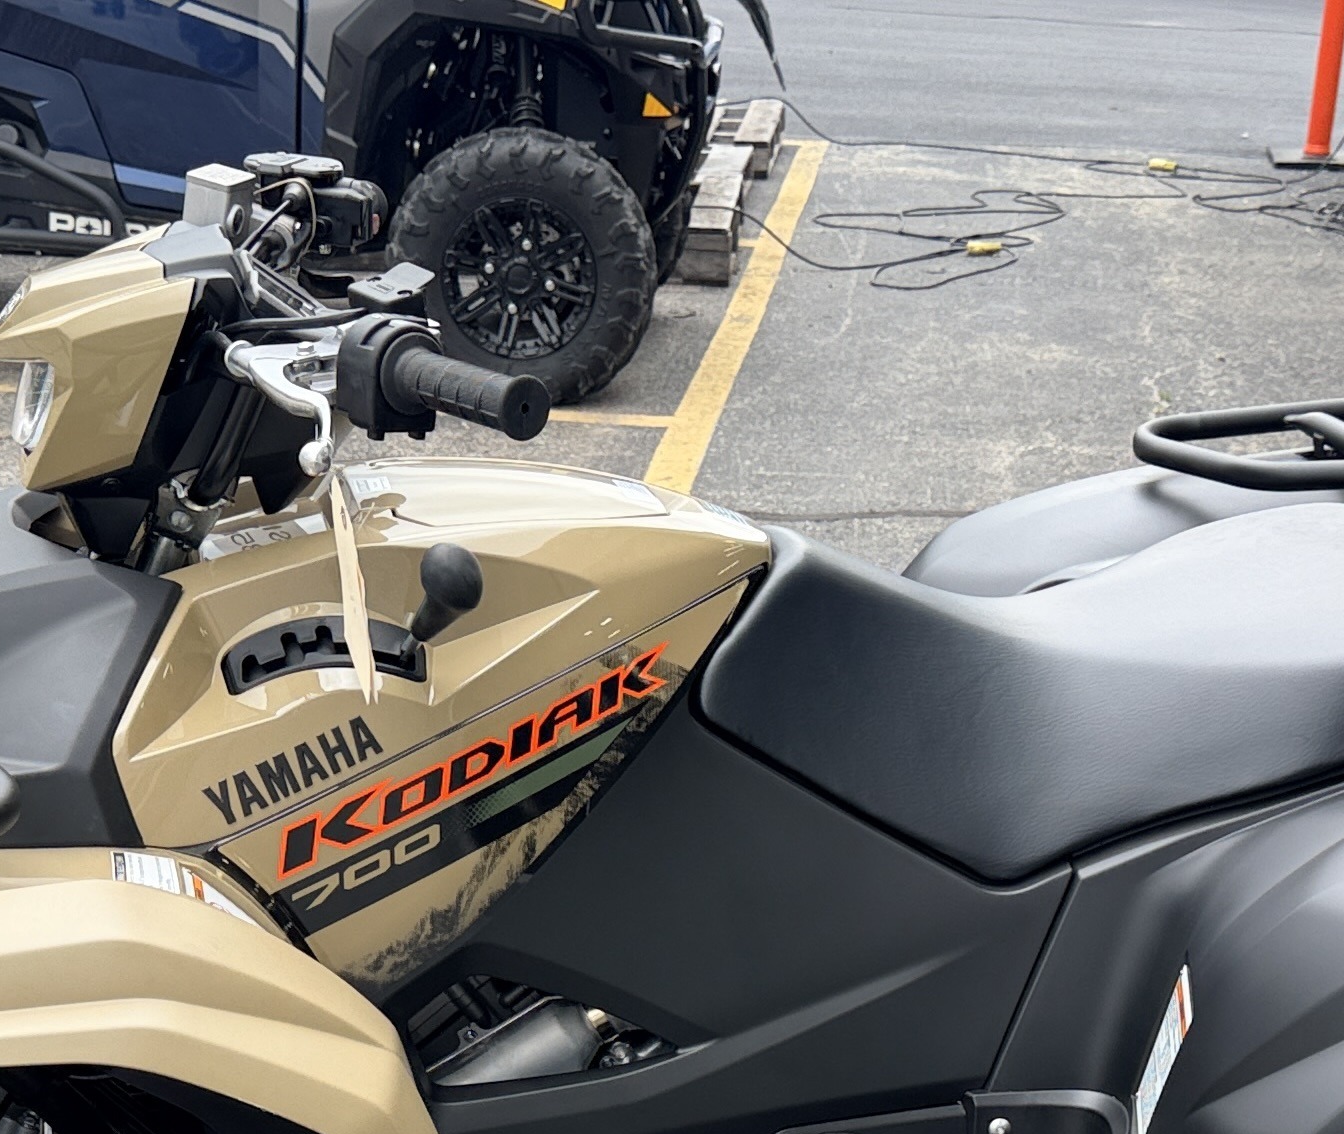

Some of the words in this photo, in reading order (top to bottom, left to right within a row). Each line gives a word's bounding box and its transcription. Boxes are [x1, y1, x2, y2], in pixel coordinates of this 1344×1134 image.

[201, 715, 384, 826] YAMAHA
[276, 641, 669, 881] KODIAK
[291, 822, 441, 912] 700
